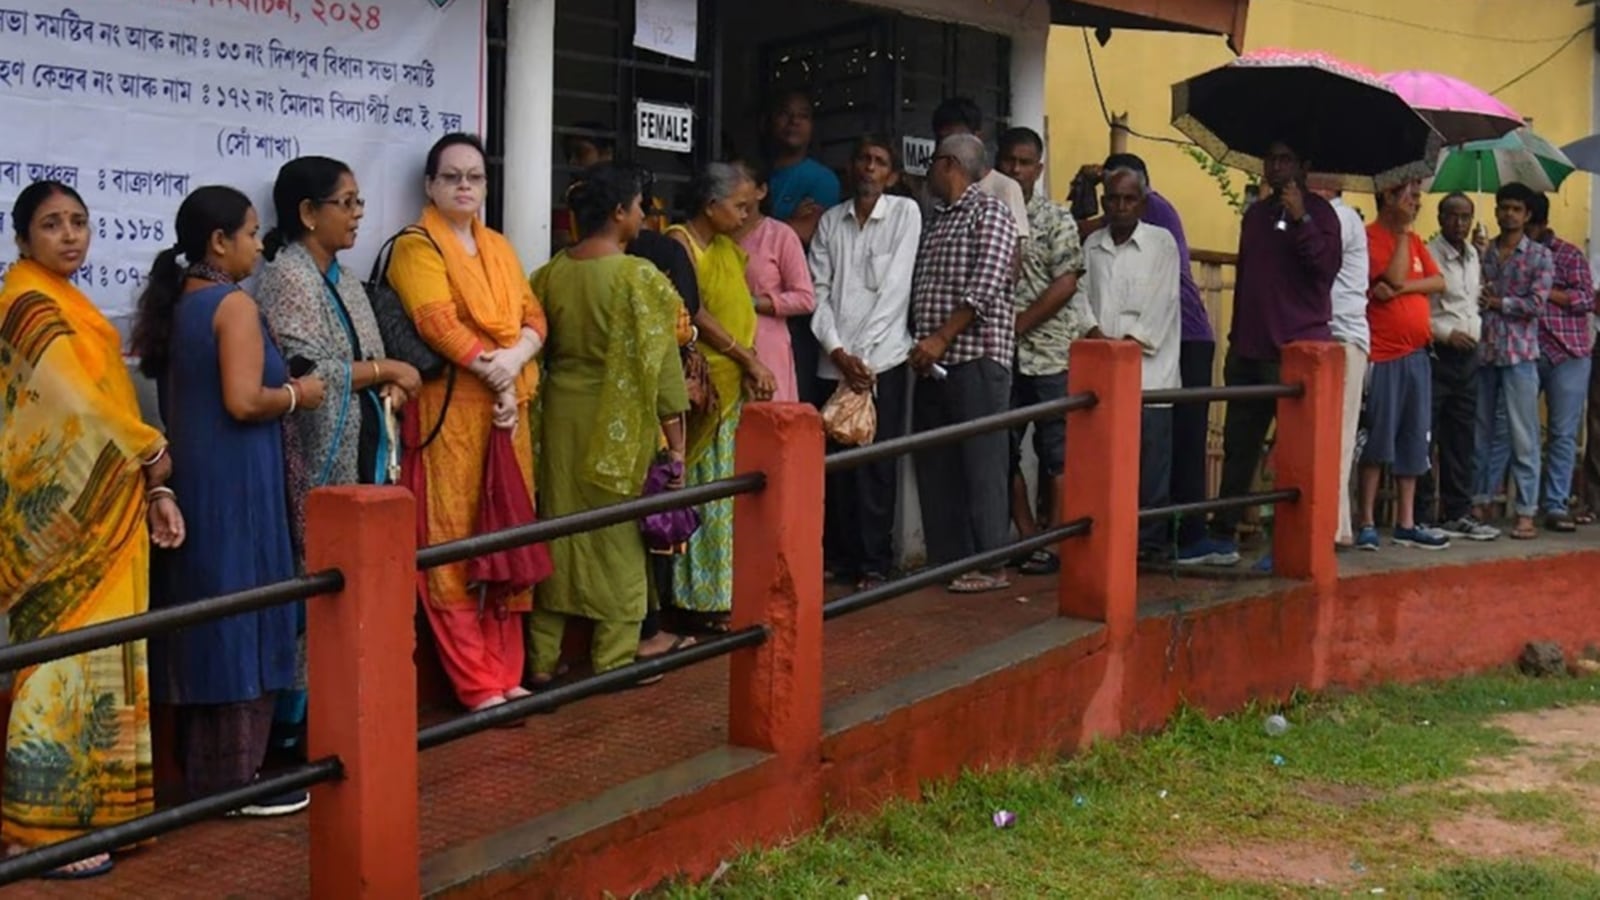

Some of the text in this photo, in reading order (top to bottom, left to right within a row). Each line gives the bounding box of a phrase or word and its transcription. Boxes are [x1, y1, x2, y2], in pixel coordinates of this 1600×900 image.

[312, 1, 380, 31] ২০২৪
[100, 23, 120, 47] নং
[169, 31, 198, 56] নাম
[216, 41, 240, 60] ৩৩
[245, 43, 264, 67] নং
[323, 46, 363, 78] বিধান
[367, 60, 398, 83] সভা
[93, 70, 113, 95] নং
[163, 78, 192, 103] নাম
[217, 86, 251, 111] ১৭২
[256, 90, 274, 113] নং
[640, 111, 689, 143] FEMALE
[114, 218, 164, 242] ১১৮৪
